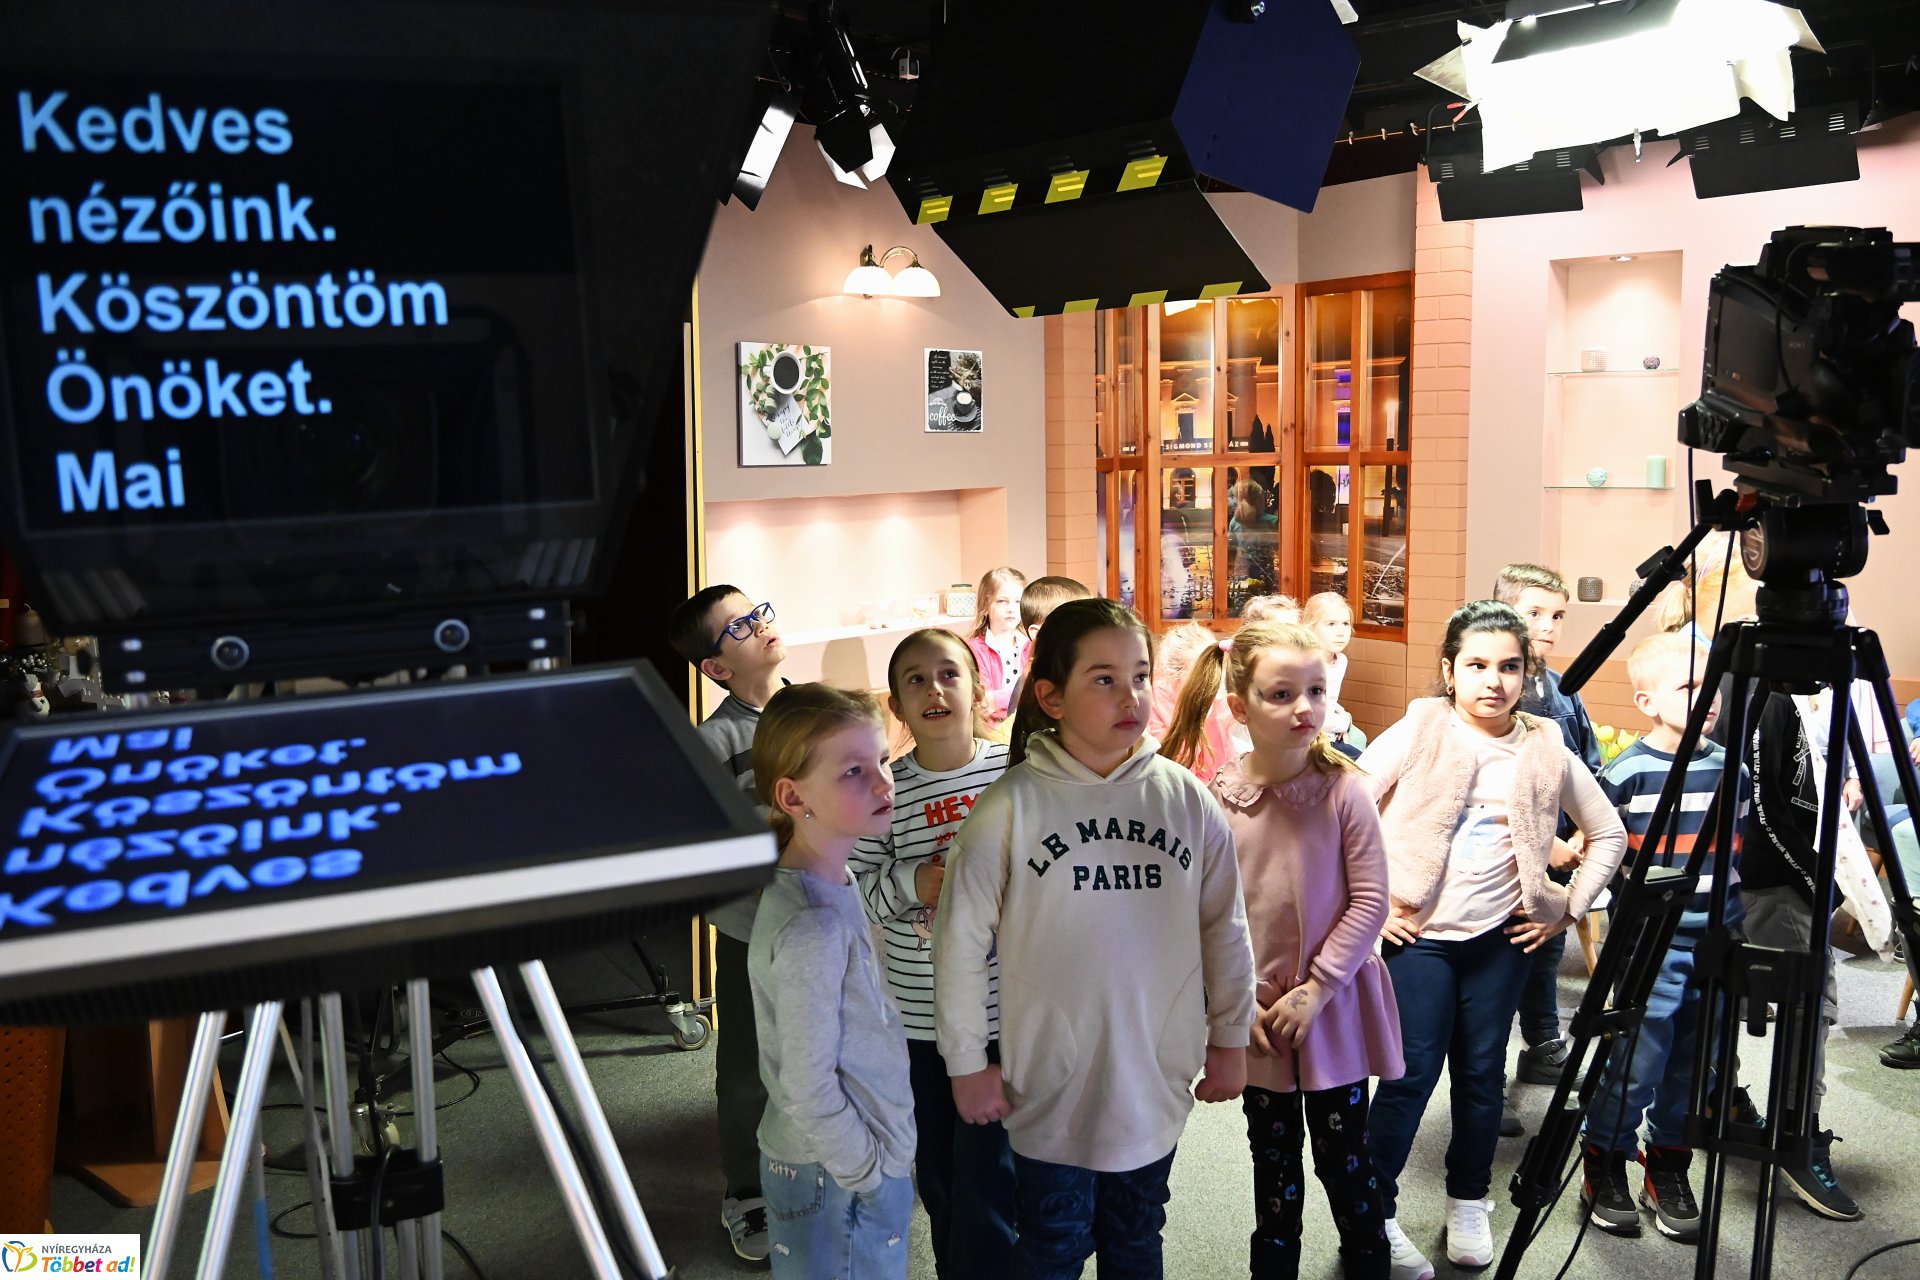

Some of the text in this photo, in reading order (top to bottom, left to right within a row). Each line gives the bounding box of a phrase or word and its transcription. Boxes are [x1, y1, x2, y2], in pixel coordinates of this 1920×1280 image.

[19, 92, 293, 155] Kedves
[29, 182, 336, 244] nézőink.
[37, 270, 449, 334] Köszöntöm
[47, 349, 332, 424] Önöket.
[56, 448, 185, 513] Mai
[924, 793, 981, 828] HEY
[1075, 817, 1193, 871] MARAIS
[1072, 863, 1163, 891] PARIS
[768, 1160, 798, 1181] Kitty
